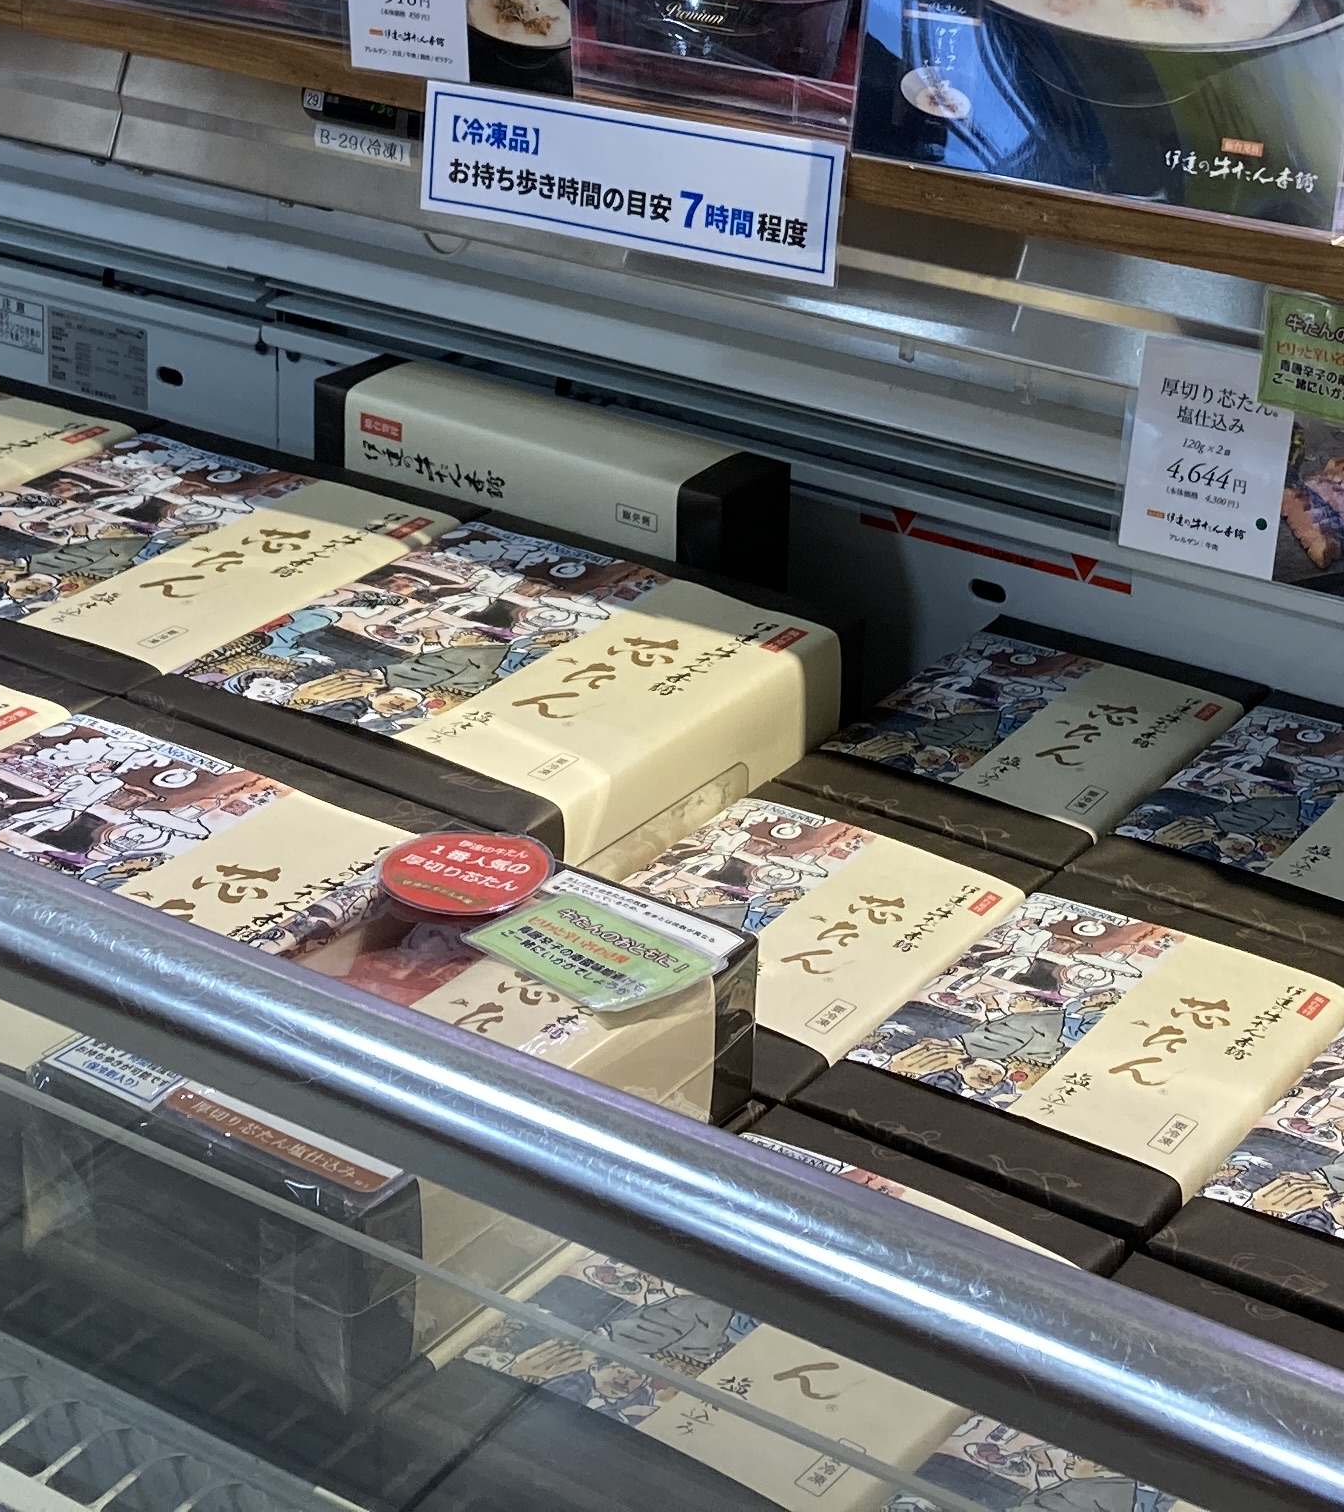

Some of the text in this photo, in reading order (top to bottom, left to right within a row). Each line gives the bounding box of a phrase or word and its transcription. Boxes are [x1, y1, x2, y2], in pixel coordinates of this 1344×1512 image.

[658, 0, 726, 26] Premium
[319, 128, 405, 163] B-29(冷凍)
[453, 115, 541, 157] 【冷凍品】
[1163, 149, 1319, 194] 伊達の牛たん本舗
[1176, 405, 1246, 435] 塩仕込み
[1166, 457, 1248, 495] 4,644円
[398, 852, 520, 892] 厚切り芯たん
[428, 843, 533, 875] 1番人気の
[556, 906, 692, 974] 牛たんのおともに！
[780, 893, 909, 976] 芯たん
[1108, 994, 1231, 1088] 芯たん
[191, 1100, 357, 1180] 厚切り芯たん塩仕込み
